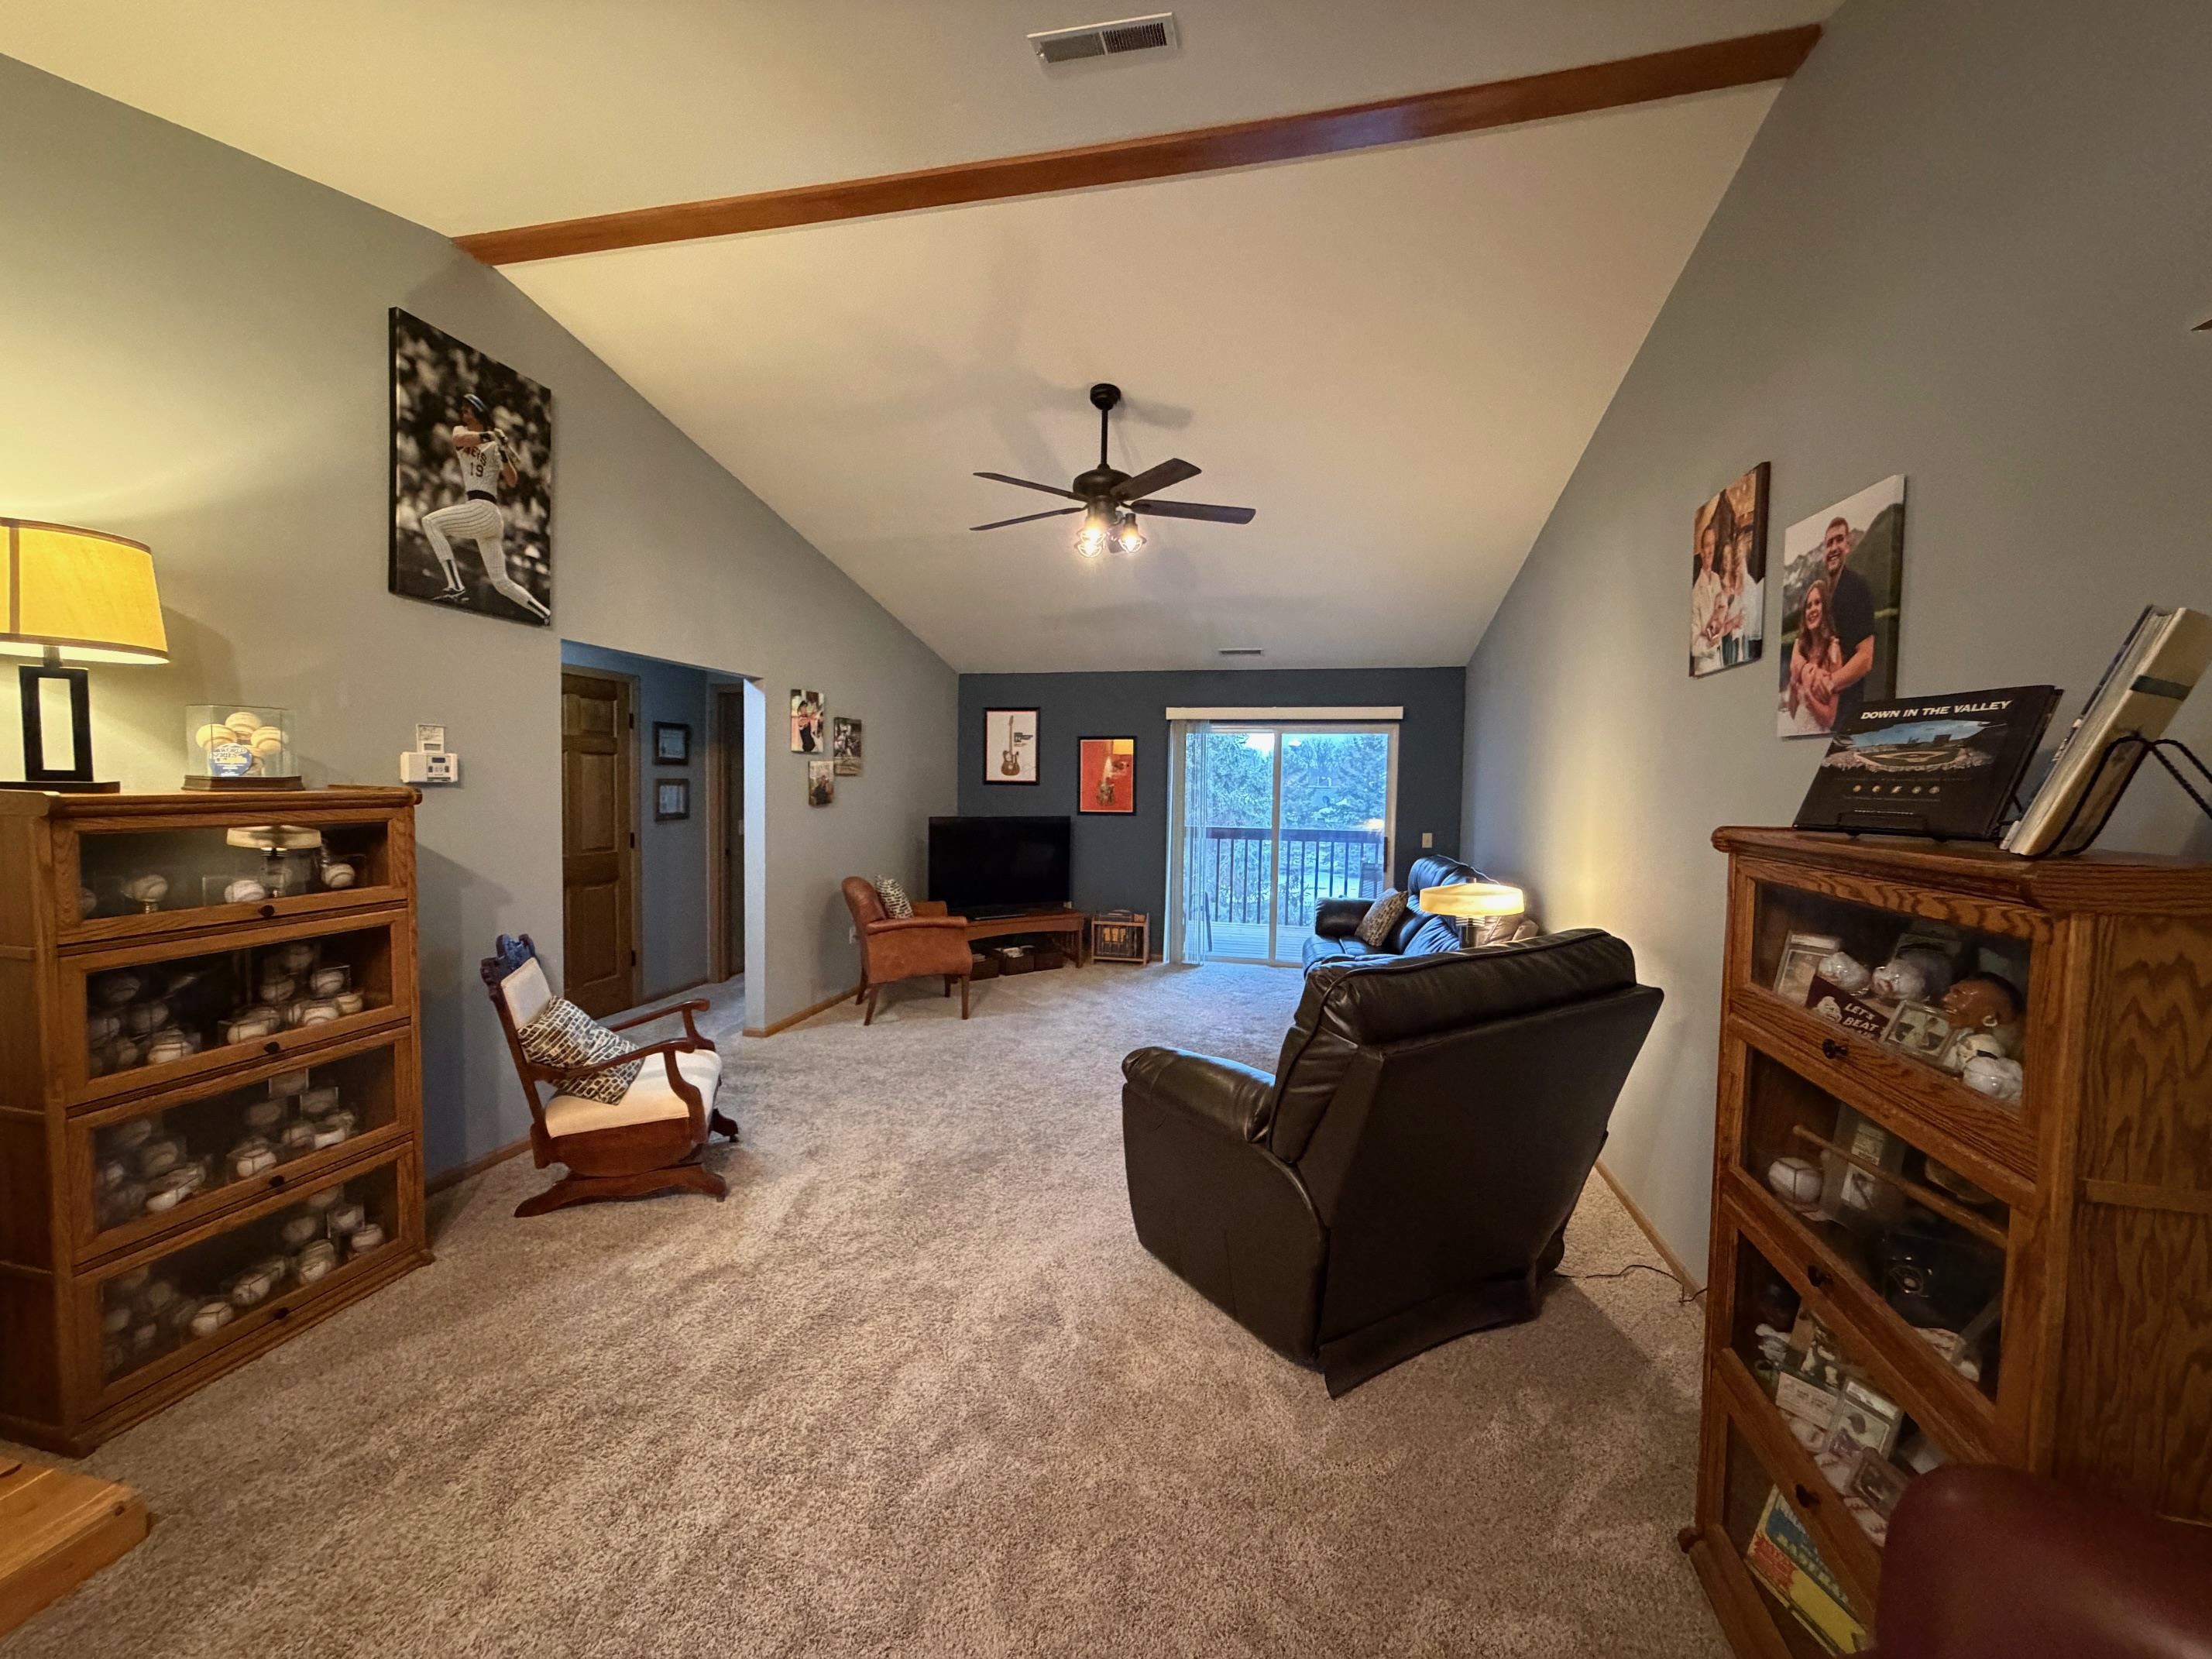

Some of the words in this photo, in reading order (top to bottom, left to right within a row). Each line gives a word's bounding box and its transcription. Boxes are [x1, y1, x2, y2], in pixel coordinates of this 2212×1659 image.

[470, 462, 484, 477] 19
[1860, 709, 1900, 720] DOWN
[1902, 708, 1918, 718] IN
[1922, 706, 1952, 716] THE
[1953, 699, 2014, 713] VALLEY
[1844, 1003, 1875, 1020] LET'S
[1843, 1017, 1880, 1031] BEAT
